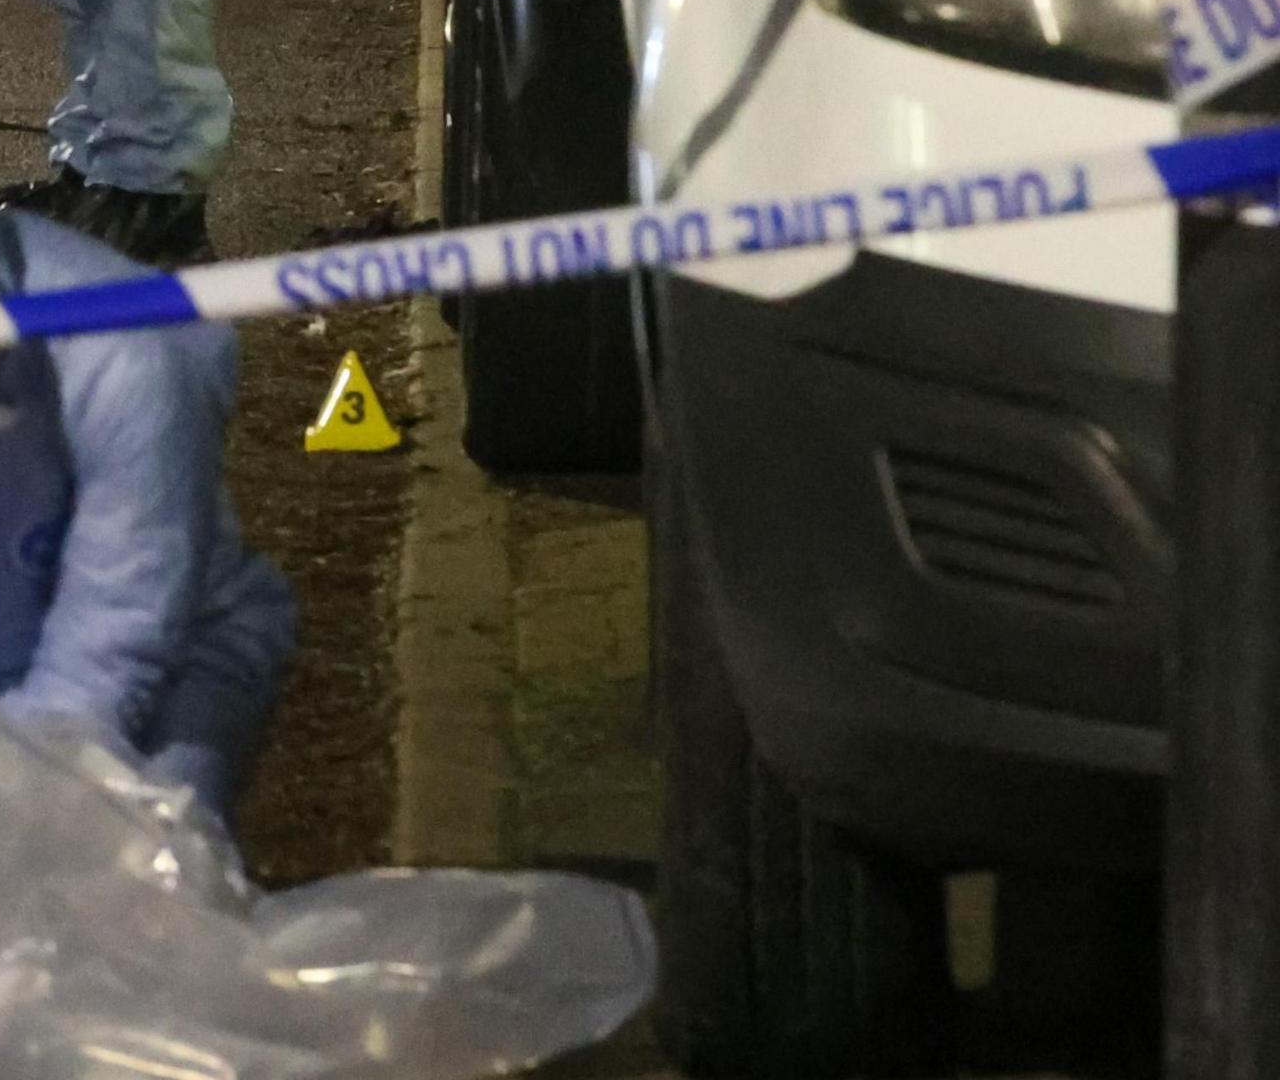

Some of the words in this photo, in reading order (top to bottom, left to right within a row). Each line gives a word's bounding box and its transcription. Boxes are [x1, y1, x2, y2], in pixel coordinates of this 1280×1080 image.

[735, 193, 859, 251] LINE
[884, 170, 1088, 233] POLICE
[503, 225, 609, 274] NOT
[633, 210, 710, 261] DO
[277, 241, 470, 304] CROSS
[342, 391, 365, 424] 3
